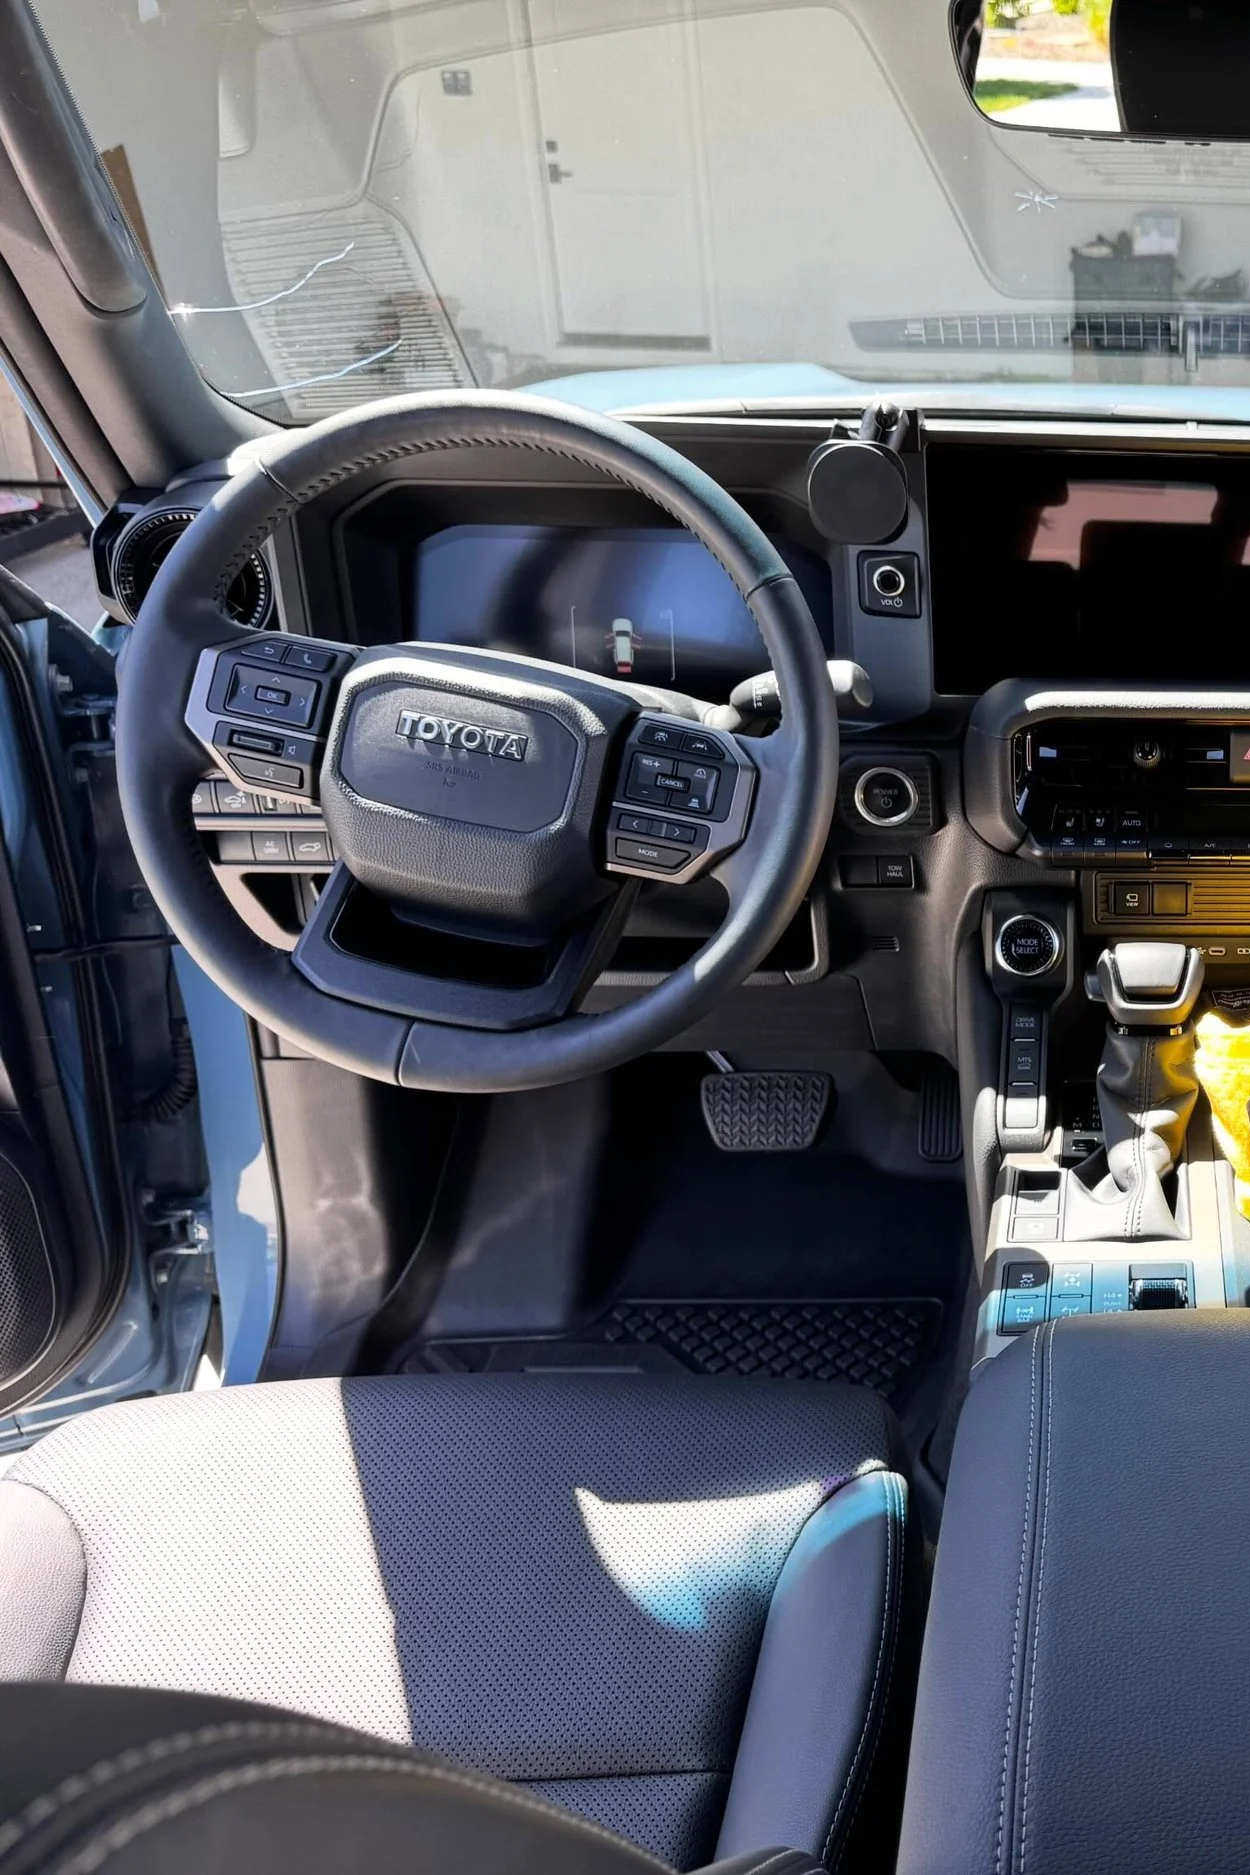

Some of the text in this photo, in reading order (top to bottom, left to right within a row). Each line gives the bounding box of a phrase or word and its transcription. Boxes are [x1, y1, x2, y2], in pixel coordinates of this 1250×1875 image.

[266, 691, 280, 701] OK
[401, 711, 524, 760] TOYOTA
[660, 777, 685, 788] CANCEL
[1122, 819, 1141, 827] AUTO
[638, 848, 659, 858] MODE
[1016, 938, 1039, 946] MODE
[1015, 946, 1039, 955] SELECT
